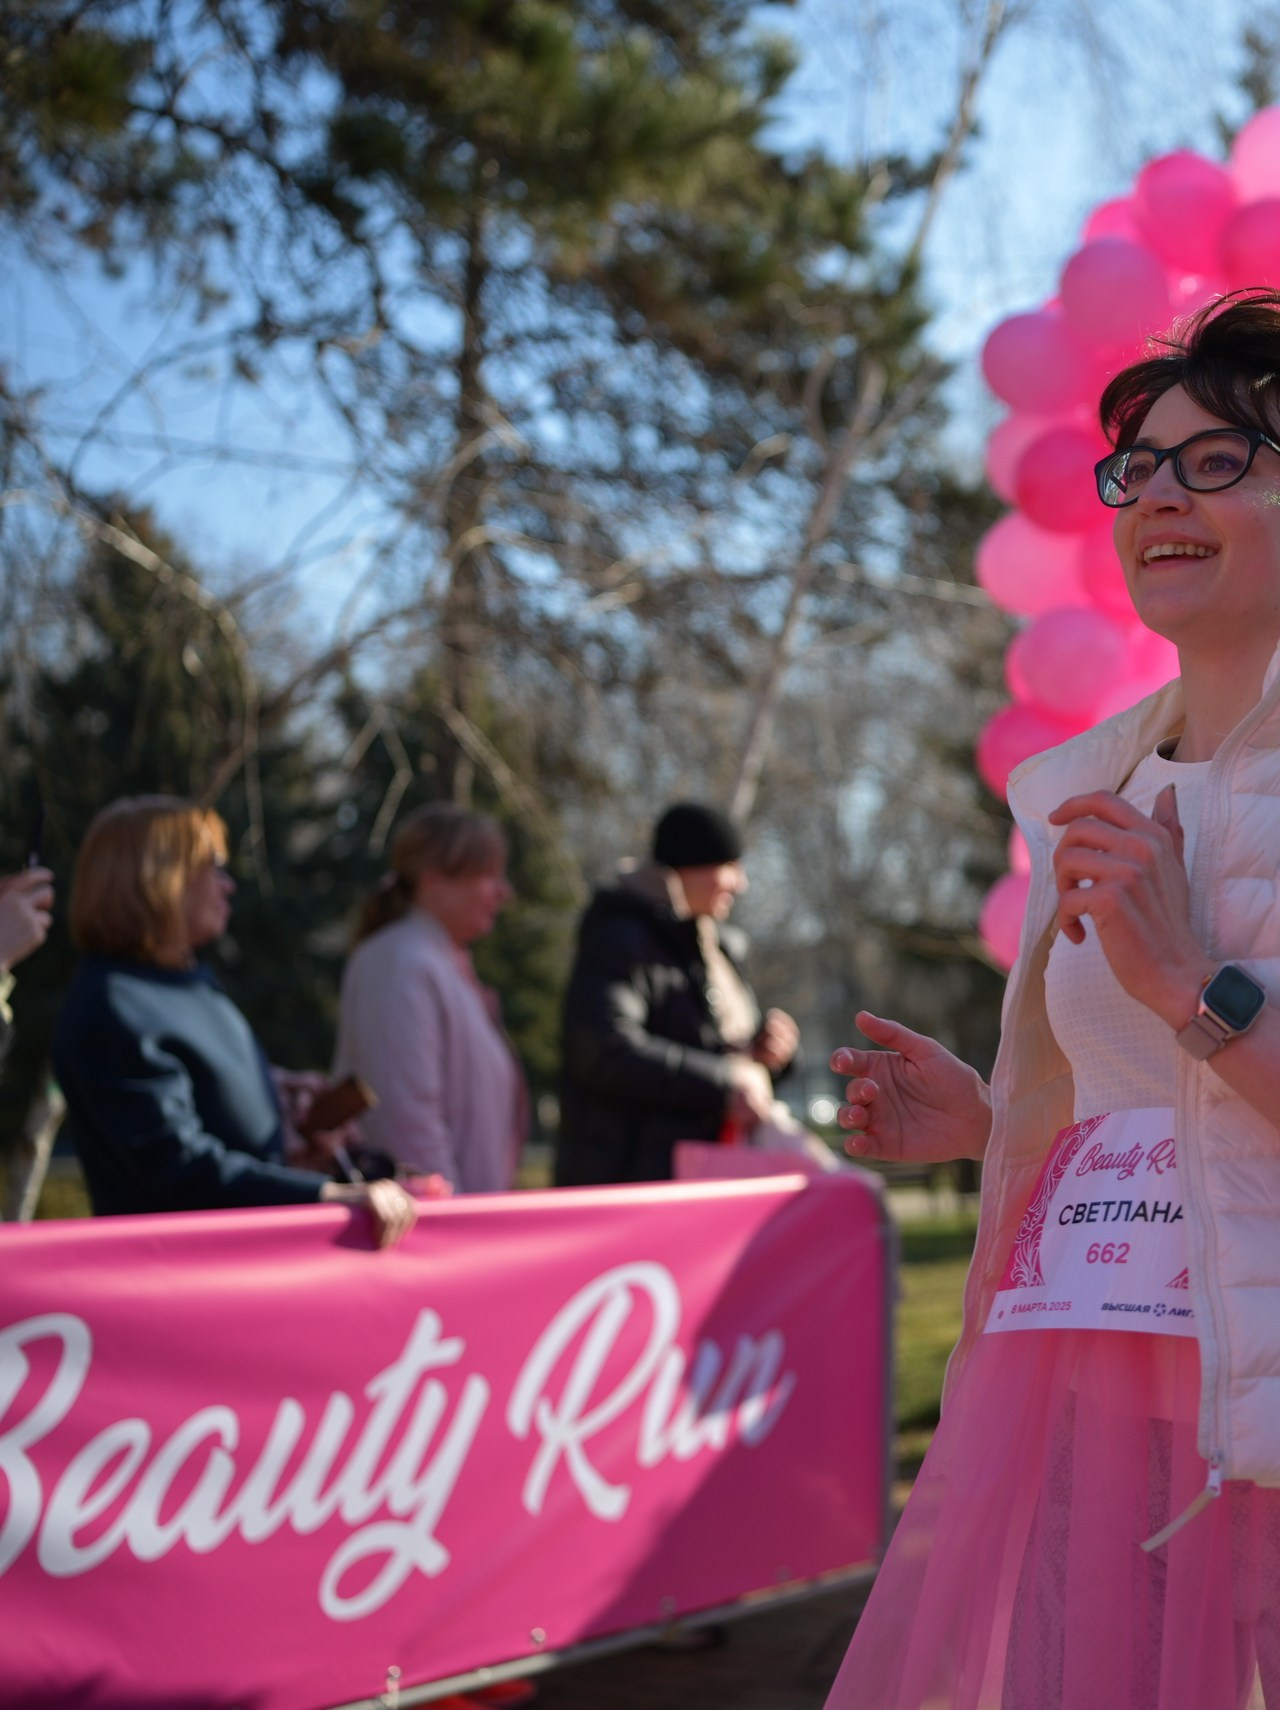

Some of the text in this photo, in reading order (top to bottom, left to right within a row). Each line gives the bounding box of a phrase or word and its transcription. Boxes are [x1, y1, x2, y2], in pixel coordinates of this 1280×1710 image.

[1076, 1138, 1177, 1180] Beauty Ru
[1086, 1242, 1131, 1264] 662
[1011, 1301, 1072, 1314] 8 МАРТА 2025
[1101, 1302, 1195, 1318] ВЫСШАЯ ЛИГ
[507, 1260, 796, 1521] Run
